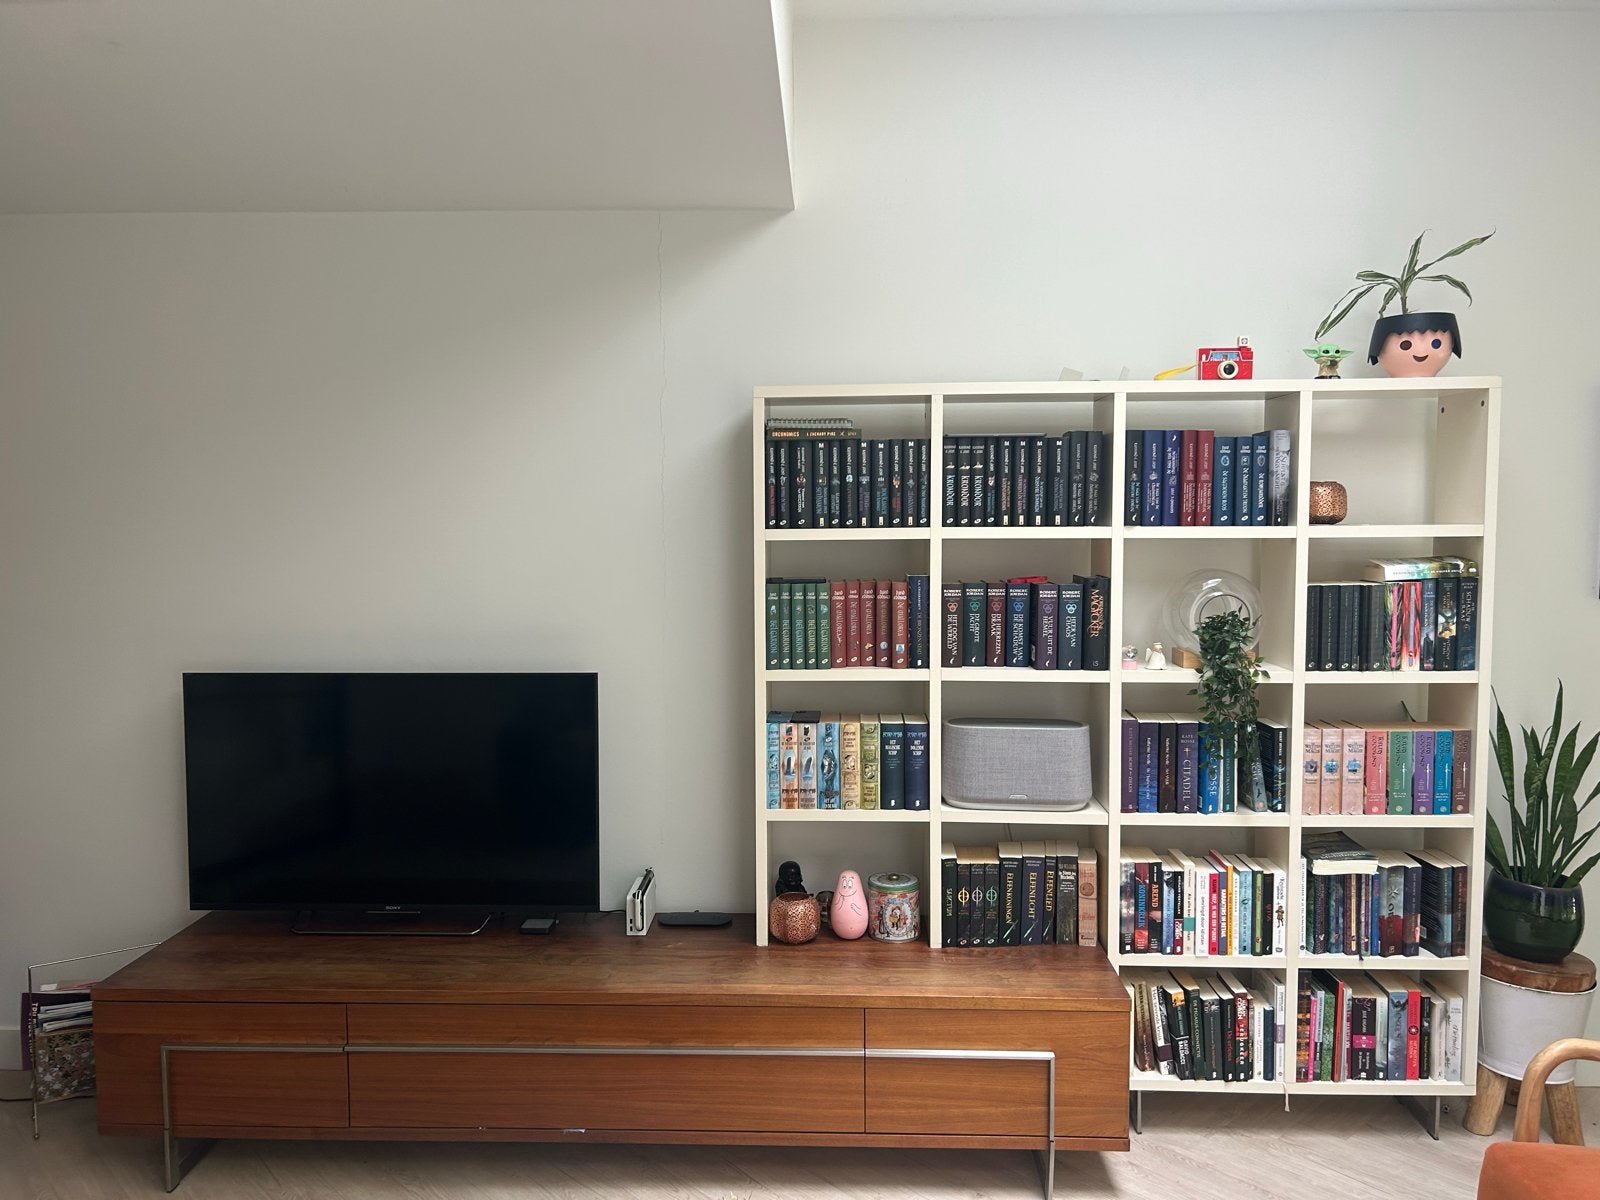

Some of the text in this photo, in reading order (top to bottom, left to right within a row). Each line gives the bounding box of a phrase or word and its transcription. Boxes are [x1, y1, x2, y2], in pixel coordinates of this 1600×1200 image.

[1088, 589, 1101, 638] MAGYCKER
[1028, 872, 1037, 919] ELFENLICHT
[1046, 871, 1054, 911] ELFENLIED
